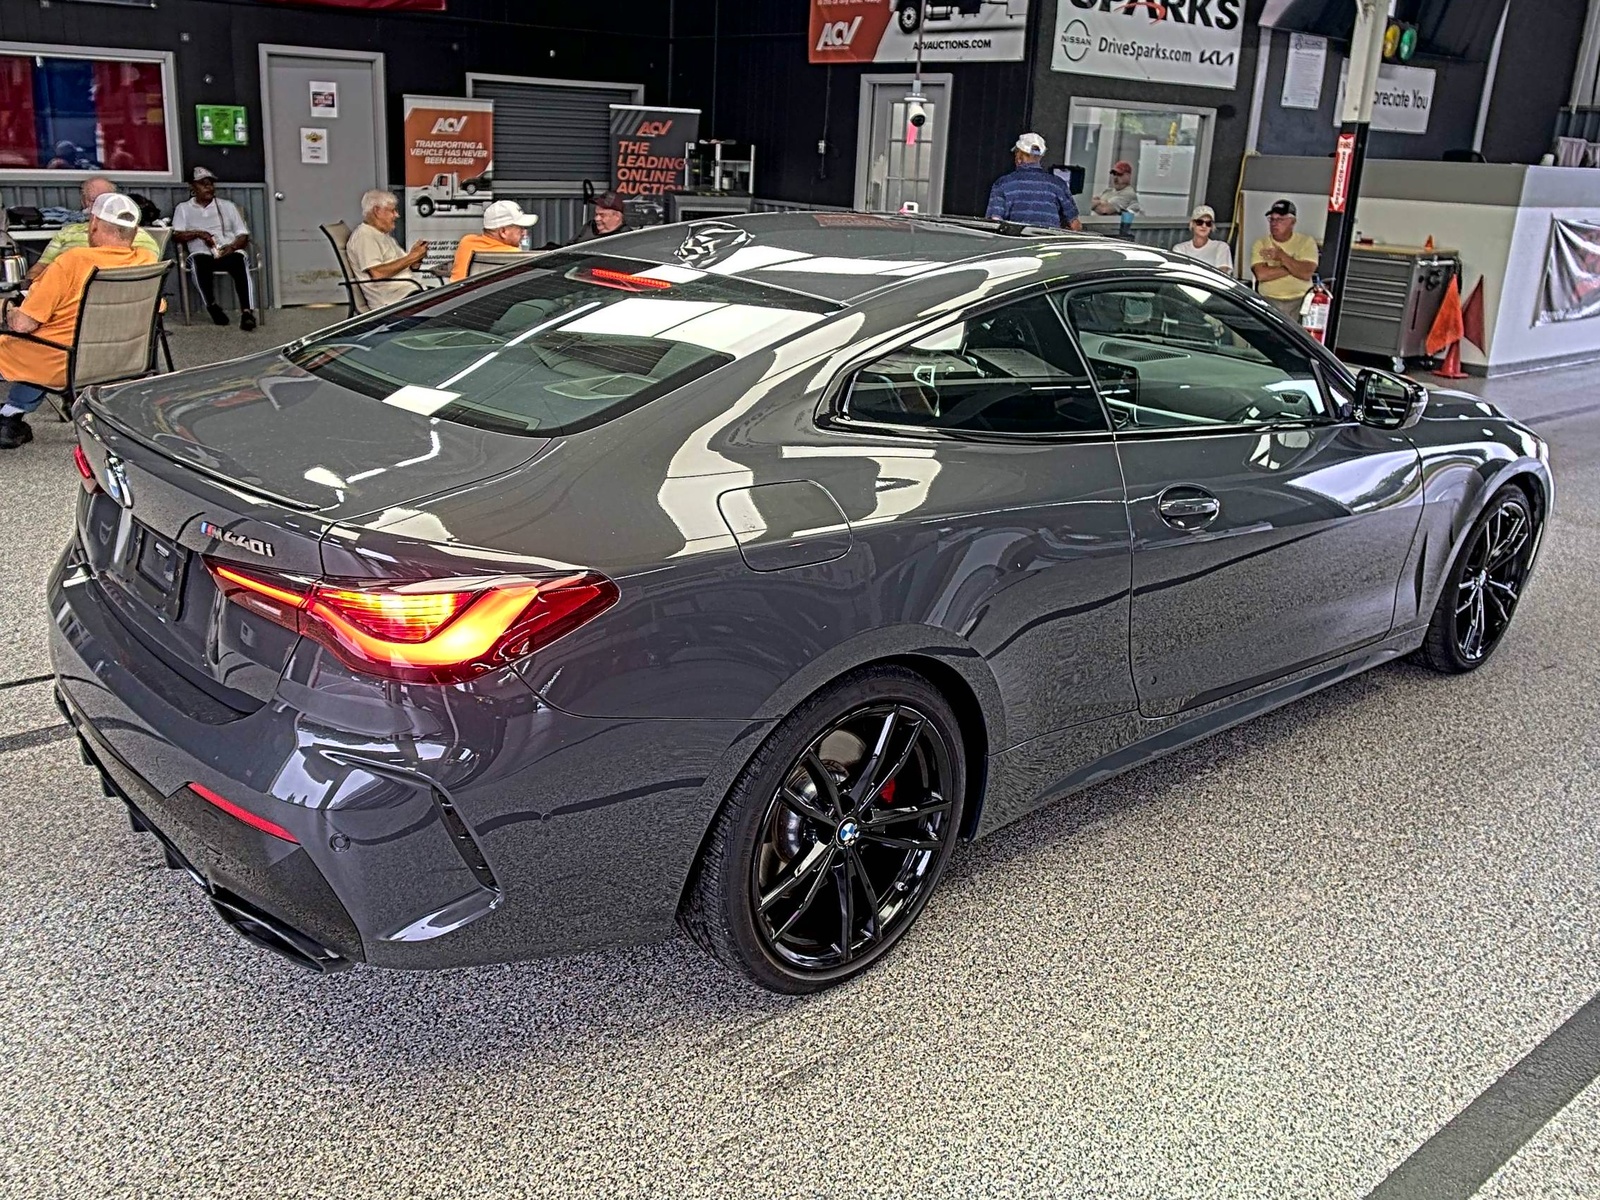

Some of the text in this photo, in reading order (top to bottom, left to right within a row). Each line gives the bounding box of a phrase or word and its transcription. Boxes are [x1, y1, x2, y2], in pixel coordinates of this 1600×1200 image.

[1070, 0, 1240, 31] ARKS
[816, 16, 863, 51] ACV
[1061, 35, 1092, 46] NISSAN
[1099, 37, 1192, 63] DriveSparks.com
[1412, 88, 1429, 110] You
[431, 116, 468, 134] ACV
[636, 119, 673, 137] ACV
[415, 140, 476, 149] TRANSPORTING
[618, 140, 650, 154] THE
[410, 148, 488, 158] VEHICLE HAS NEVER
[424, 157, 474, 165] BEEN EASIER
[617, 155, 685, 170] LEADING
[617, 168, 677, 183] ONLINE
[207, 523, 273, 557] M440i
